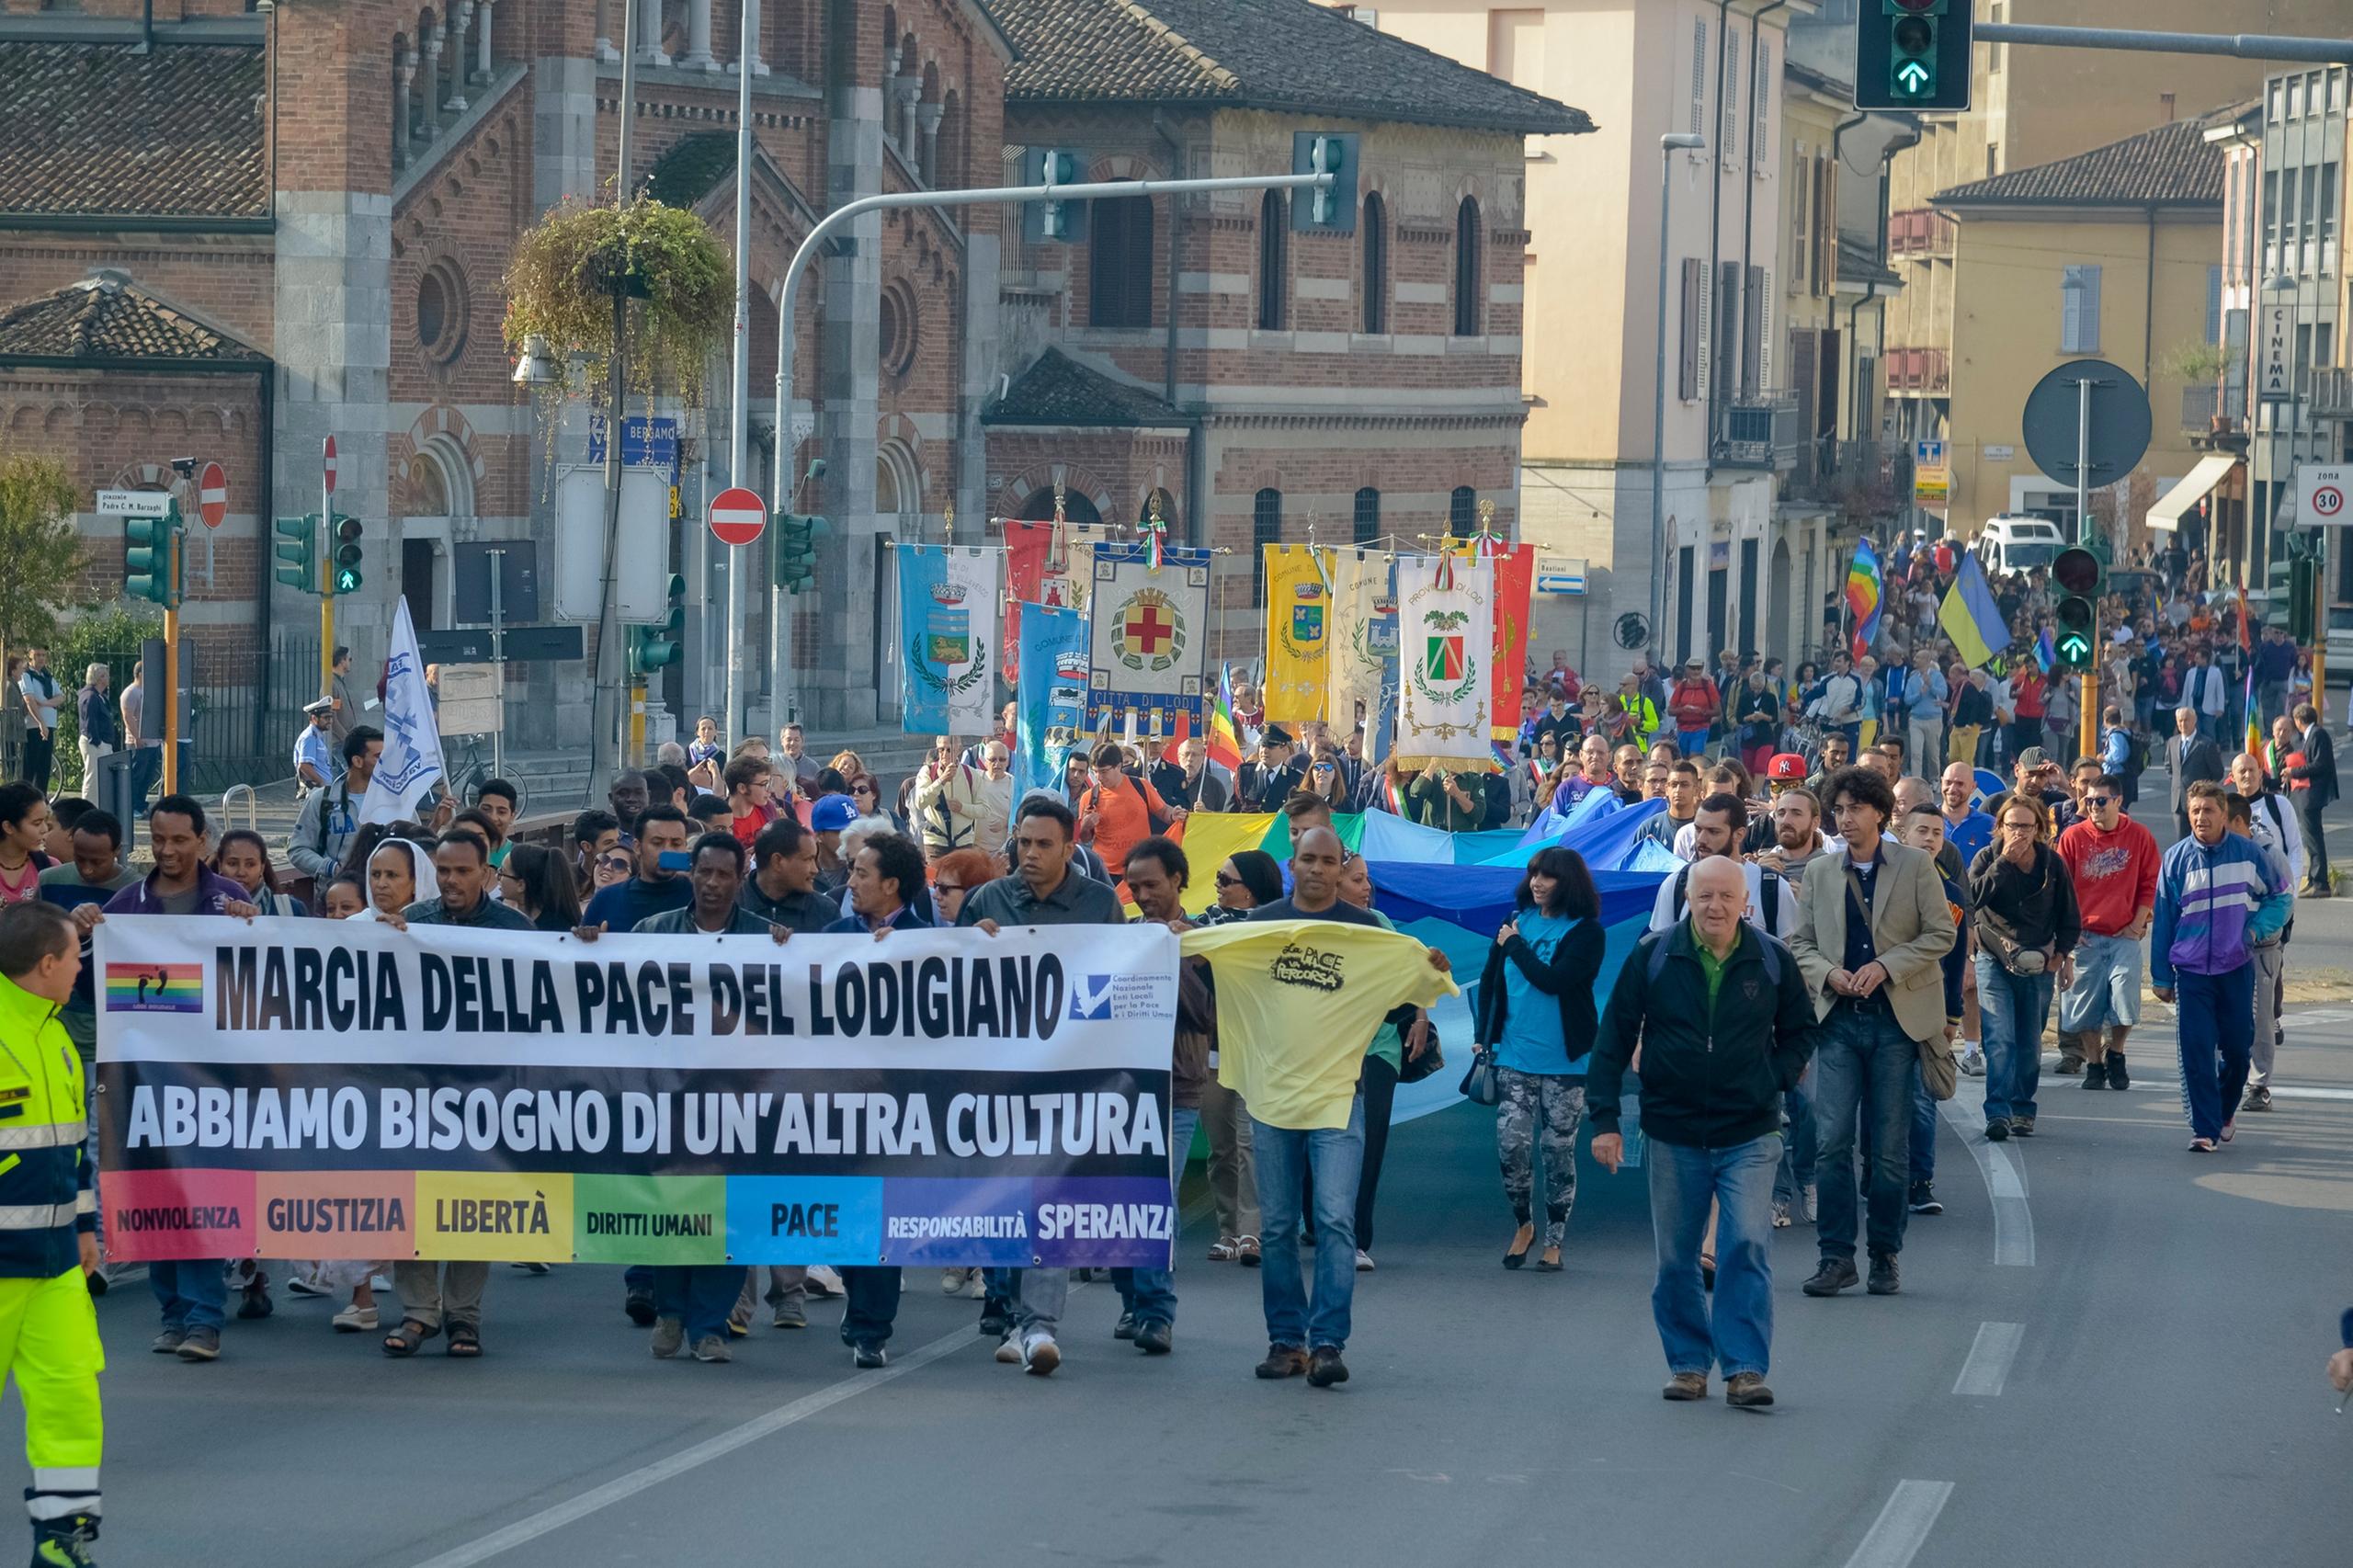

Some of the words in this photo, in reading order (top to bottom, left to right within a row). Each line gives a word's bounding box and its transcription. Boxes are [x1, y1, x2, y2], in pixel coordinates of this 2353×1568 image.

[2269, 310, 2283, 388] CINEMA
[137, 503, 162, 512] Barzaghi
[2318, 494, 2337, 507] 30
[1273, 564, 1302, 583] COMUNE
[1465, 588, 1484, 607] LODI
[1142, 694, 1154, 707] DI
[1165, 696, 1194, 710] LODI
[841, 801, 857, 819] LA
[1303, 947, 1345, 971] PACE
[1112, 974, 1172, 983] Coordinamento
[1112, 983, 1153, 992] Nazionale
[216, 946, 407, 1032] MARCIA
[420, 952, 564, 1033] DELLA
[574, 960, 694, 1037] PACE
[709, 962, 794, 1036] DEL
[809, 953, 1064, 1040] LODIGIANO
[127, 1085, 368, 1150] ABBIAMO
[380, 1087, 610, 1153] BISOGNO
[621, 1092, 671, 1153] DI
[684, 1092, 937, 1155] UN'ALTRA
[947, 1092, 1165, 1157] CULTURA
[117, 1207, 241, 1232] NONVIOLENZA
[267, 1198, 406, 1233] GIUSTIZIA
[436, 1190, 550, 1234] LIBERTÀ
[587, 1212, 648, 1236] DIRITTI
[652, 1213, 711, 1236] UMANI
[771, 1202, 839, 1237] PACE
[888, 1210, 1028, 1239] RESPONSABILITÀ
